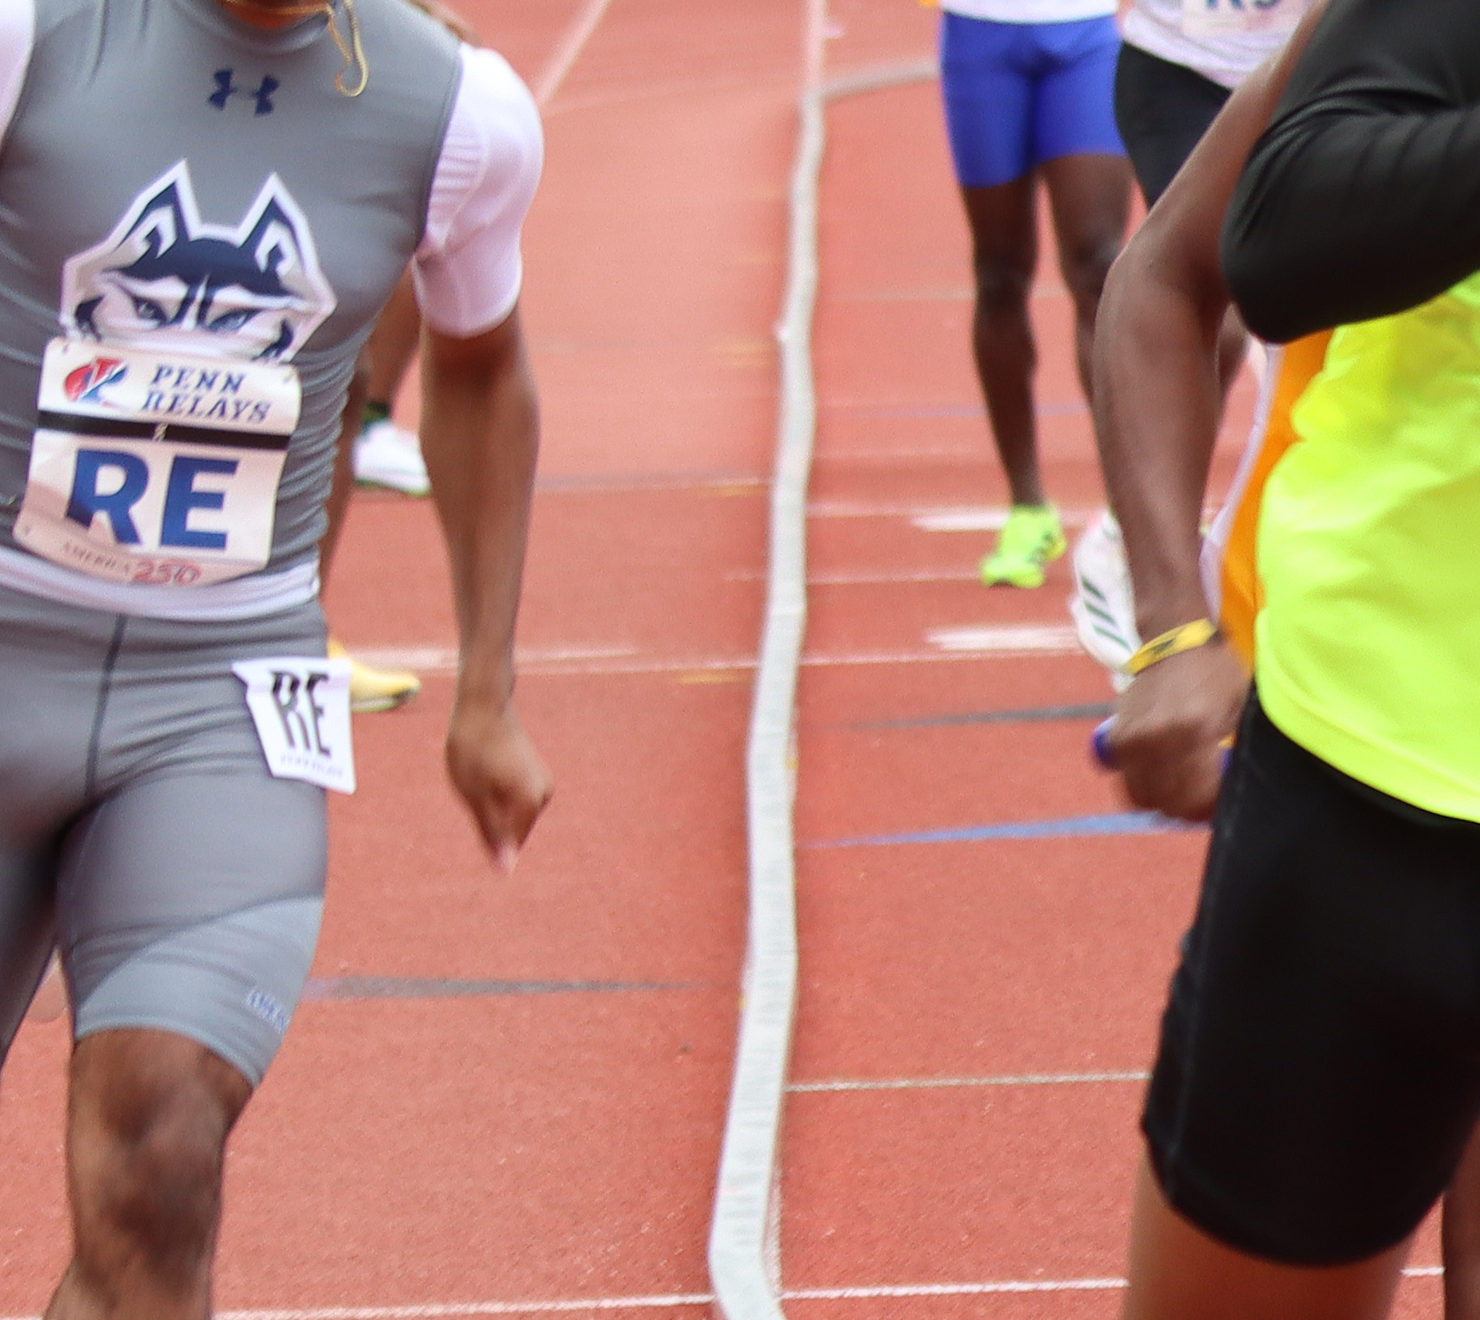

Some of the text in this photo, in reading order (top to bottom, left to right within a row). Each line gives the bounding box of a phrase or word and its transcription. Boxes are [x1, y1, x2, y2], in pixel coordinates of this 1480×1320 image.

[140, 392, 272, 422] RELAYS
[151, 364, 248, 393] PENN
[65, 448, 240, 550] RE
[270, 670, 331, 758] RE
